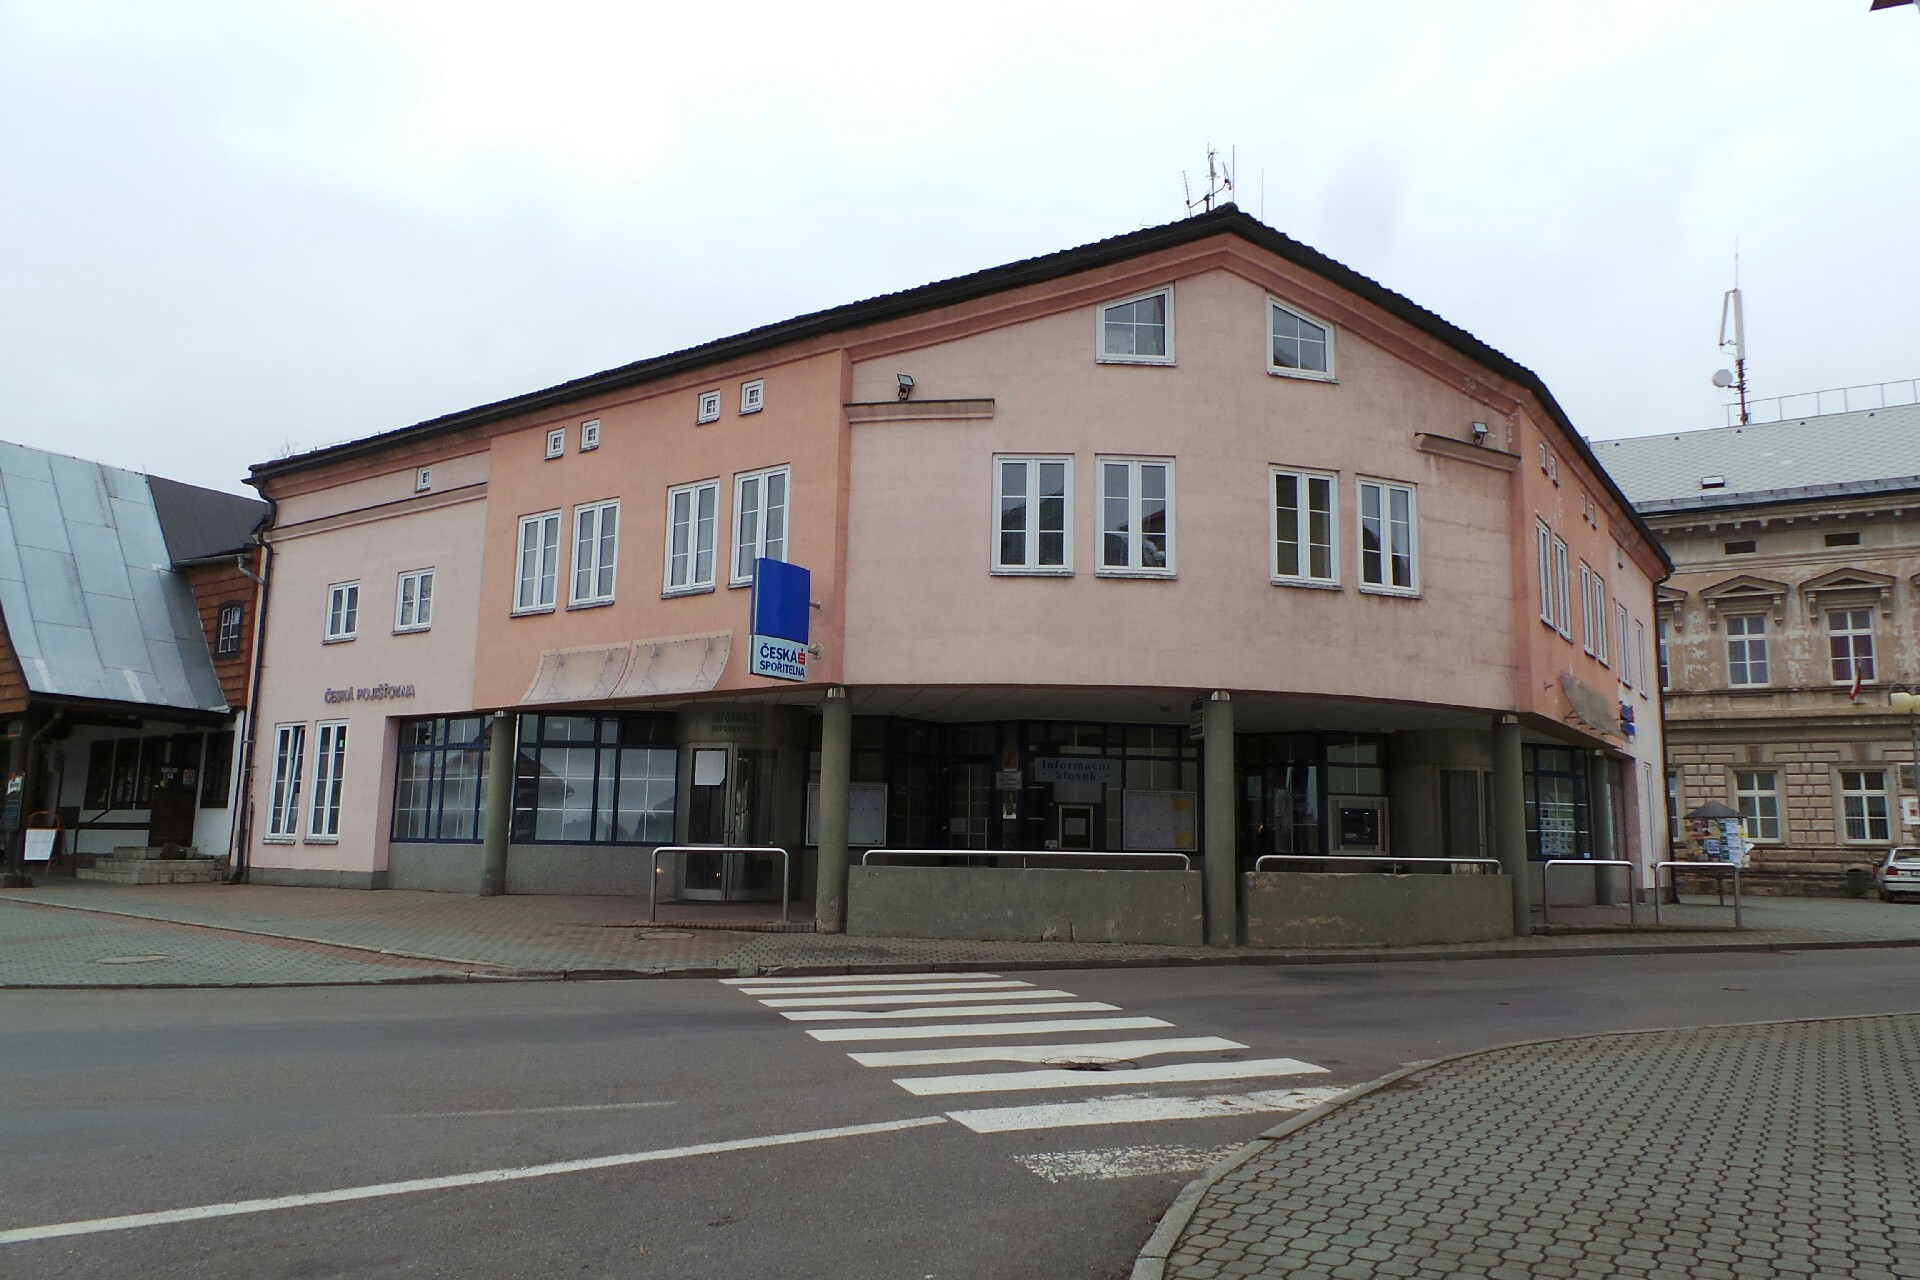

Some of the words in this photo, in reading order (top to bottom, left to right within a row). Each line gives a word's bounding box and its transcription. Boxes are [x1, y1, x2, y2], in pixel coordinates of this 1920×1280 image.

[760, 642, 797, 664] ČESKÁ
[760, 660, 805, 677] SPOŘITELNA
[324, 686, 354, 703] ČESKÁ
[712, 711, 758, 724] INFORMACE
